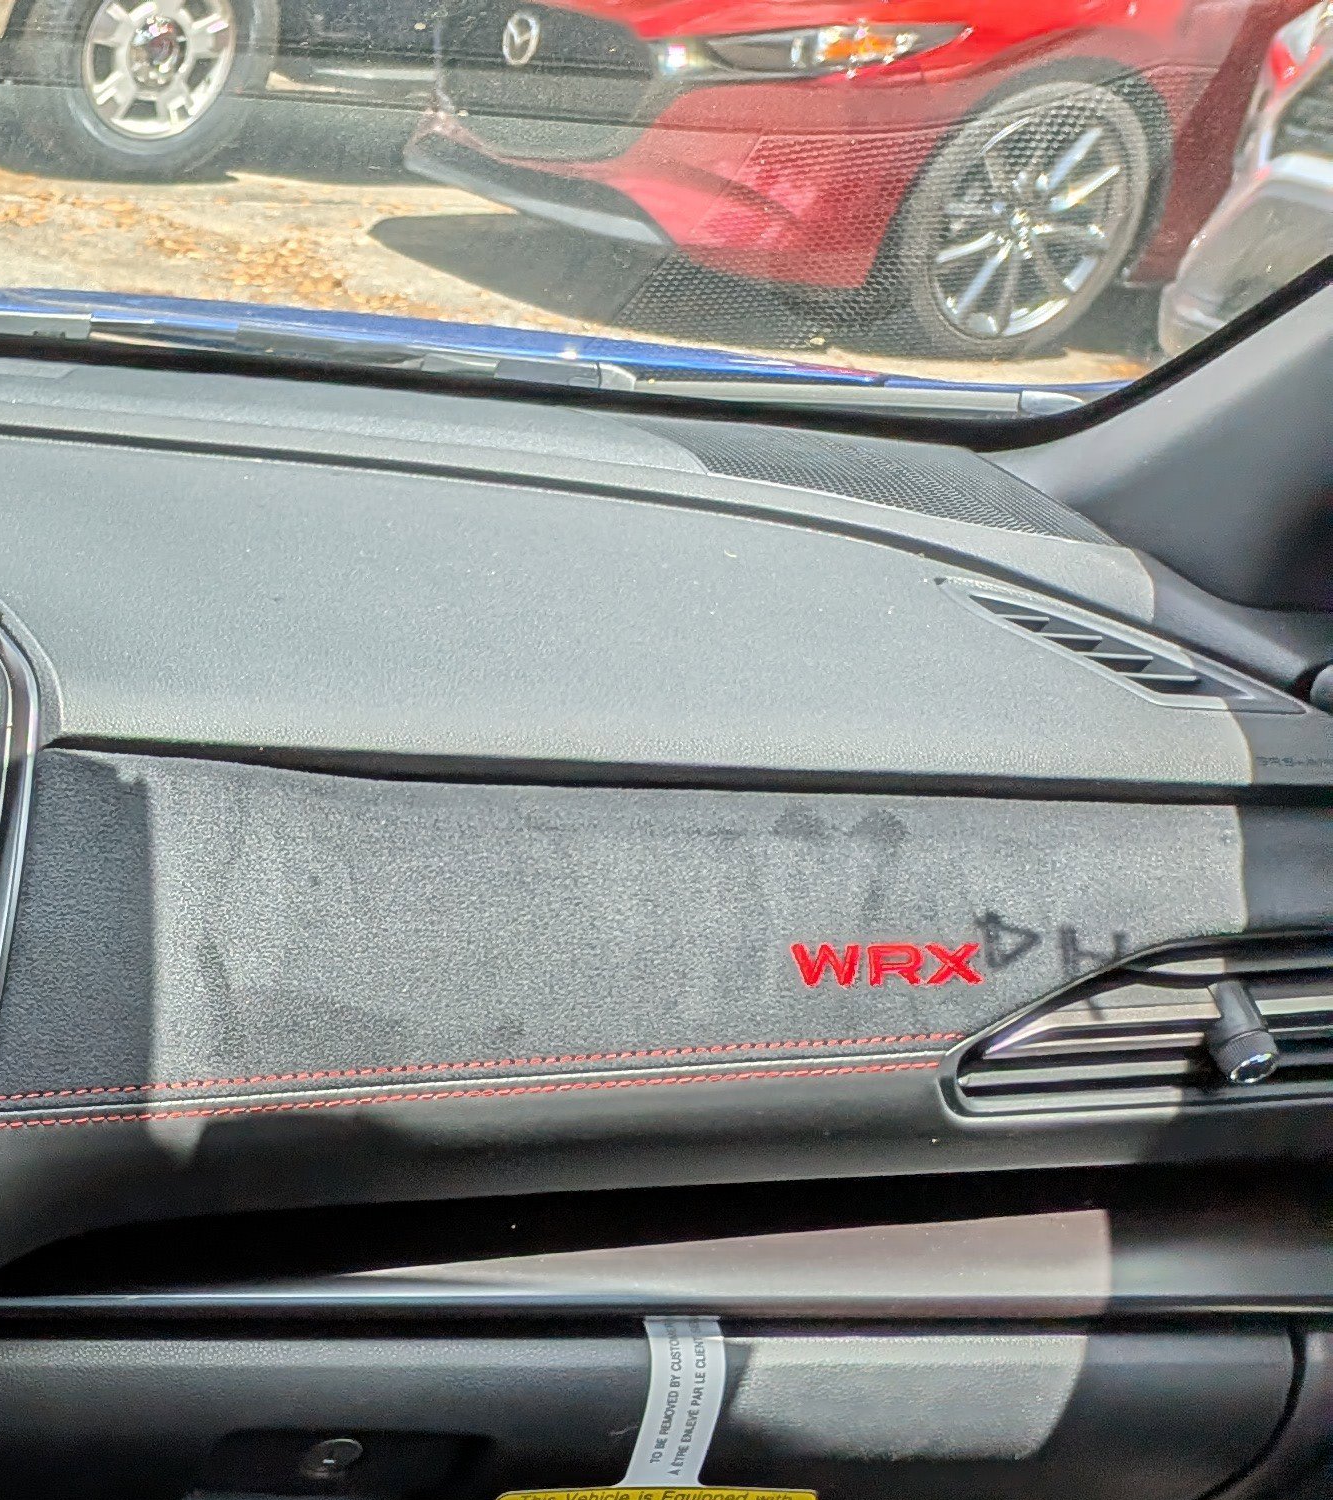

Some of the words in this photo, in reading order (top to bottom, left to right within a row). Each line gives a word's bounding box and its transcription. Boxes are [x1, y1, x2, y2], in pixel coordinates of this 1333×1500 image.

[790, 942, 983, 988] WRX
[670, 1376, 680, 1388] BY
[695, 1372, 706, 1384] LE
[691, 1388, 704, 1406] PAR
[659, 1391, 679, 1435] REMOVED
[655, 1438, 667, 1449] BE
[650, 1451, 663, 1463] TO
